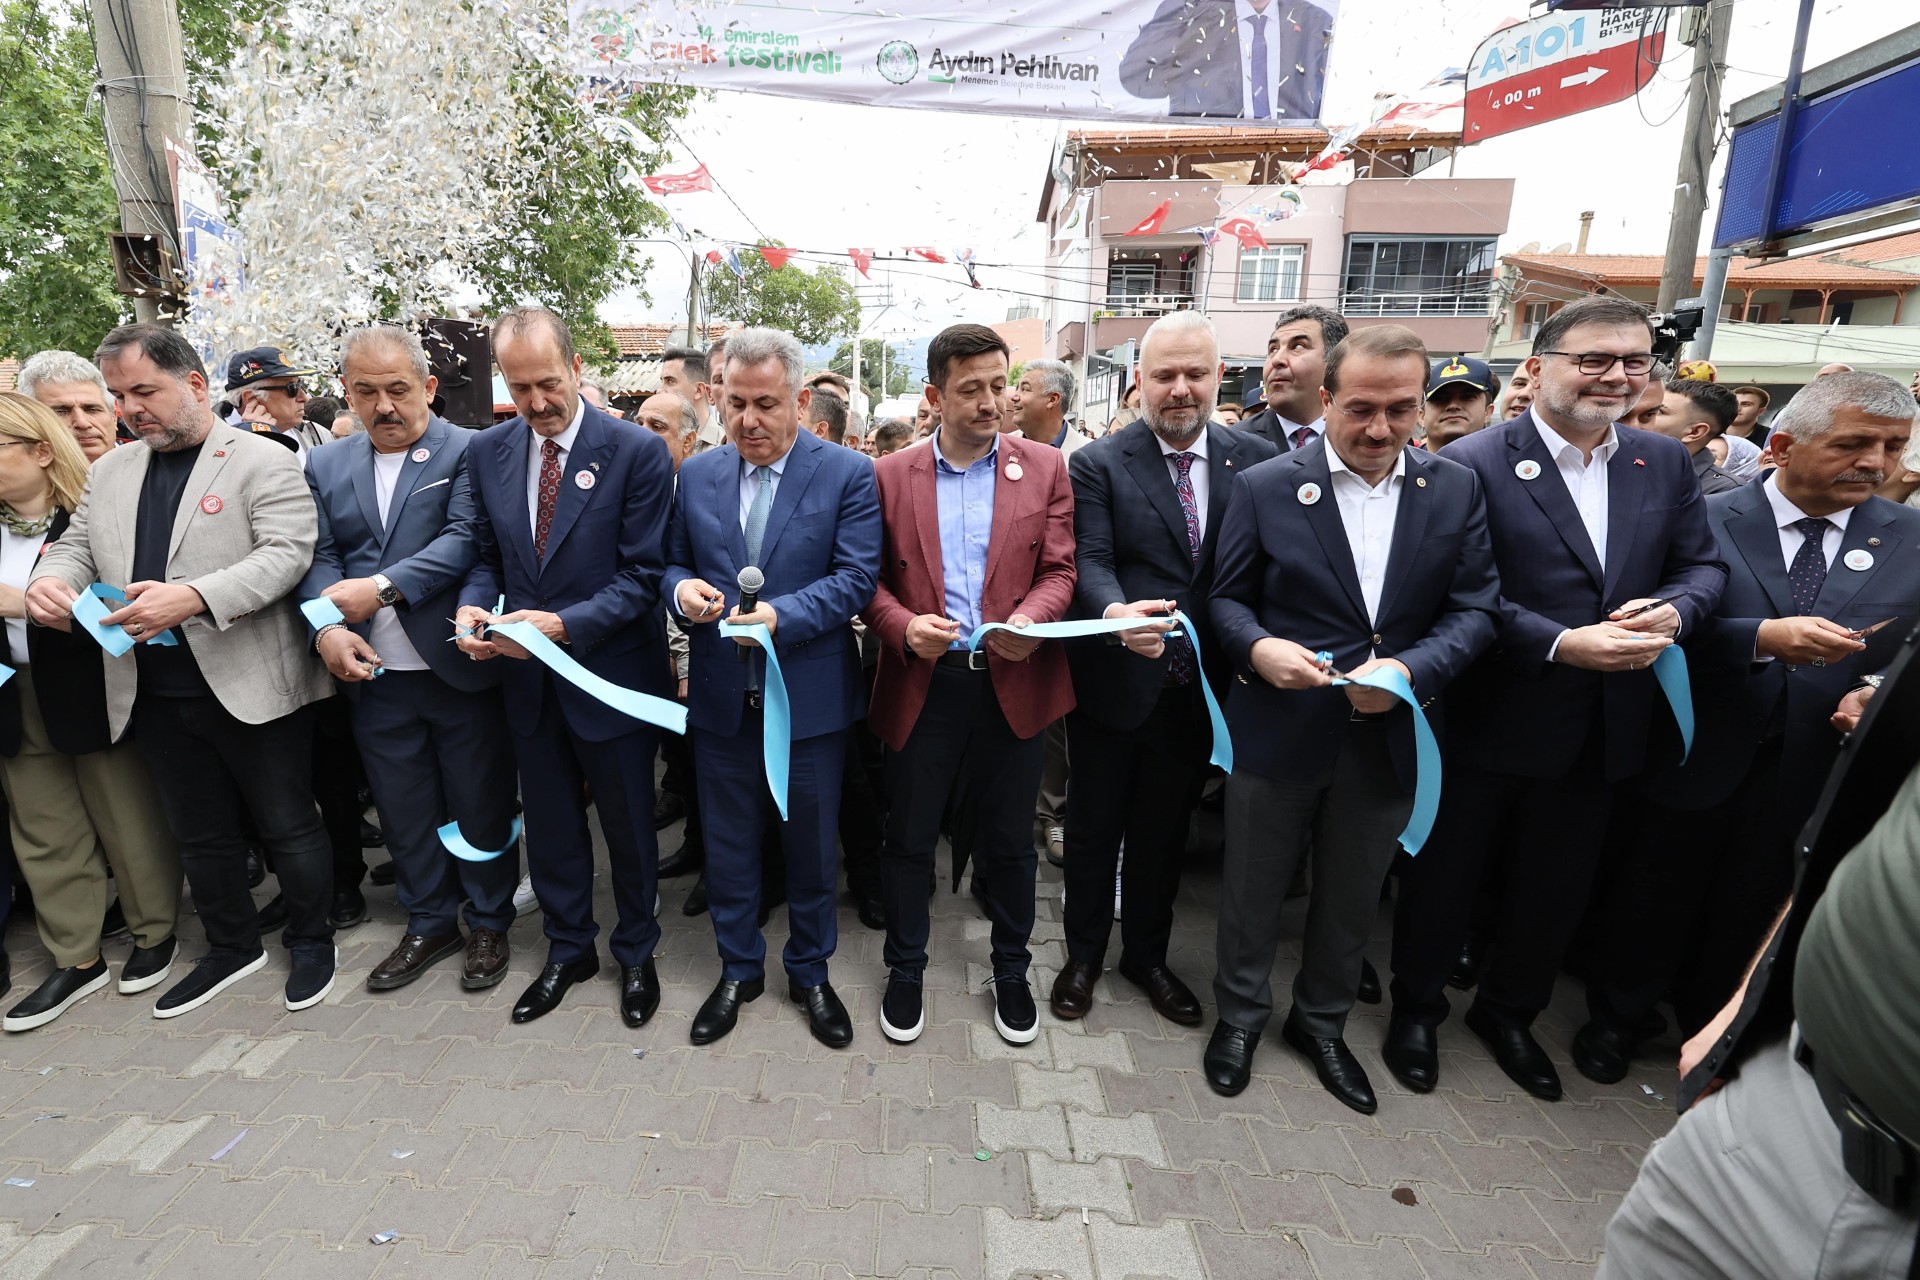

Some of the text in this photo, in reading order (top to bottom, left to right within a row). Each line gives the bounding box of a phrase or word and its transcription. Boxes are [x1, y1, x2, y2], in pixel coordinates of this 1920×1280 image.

[724, 28, 799, 46] emiralem
[1479, 16, 1585, 78] A-101
[727, 44, 842, 74] festivali
[928, 48, 1099, 82] Aydın Pehlivan
[961, 75, 999, 86] Menemen
[1527, 86, 1541, 98] m
